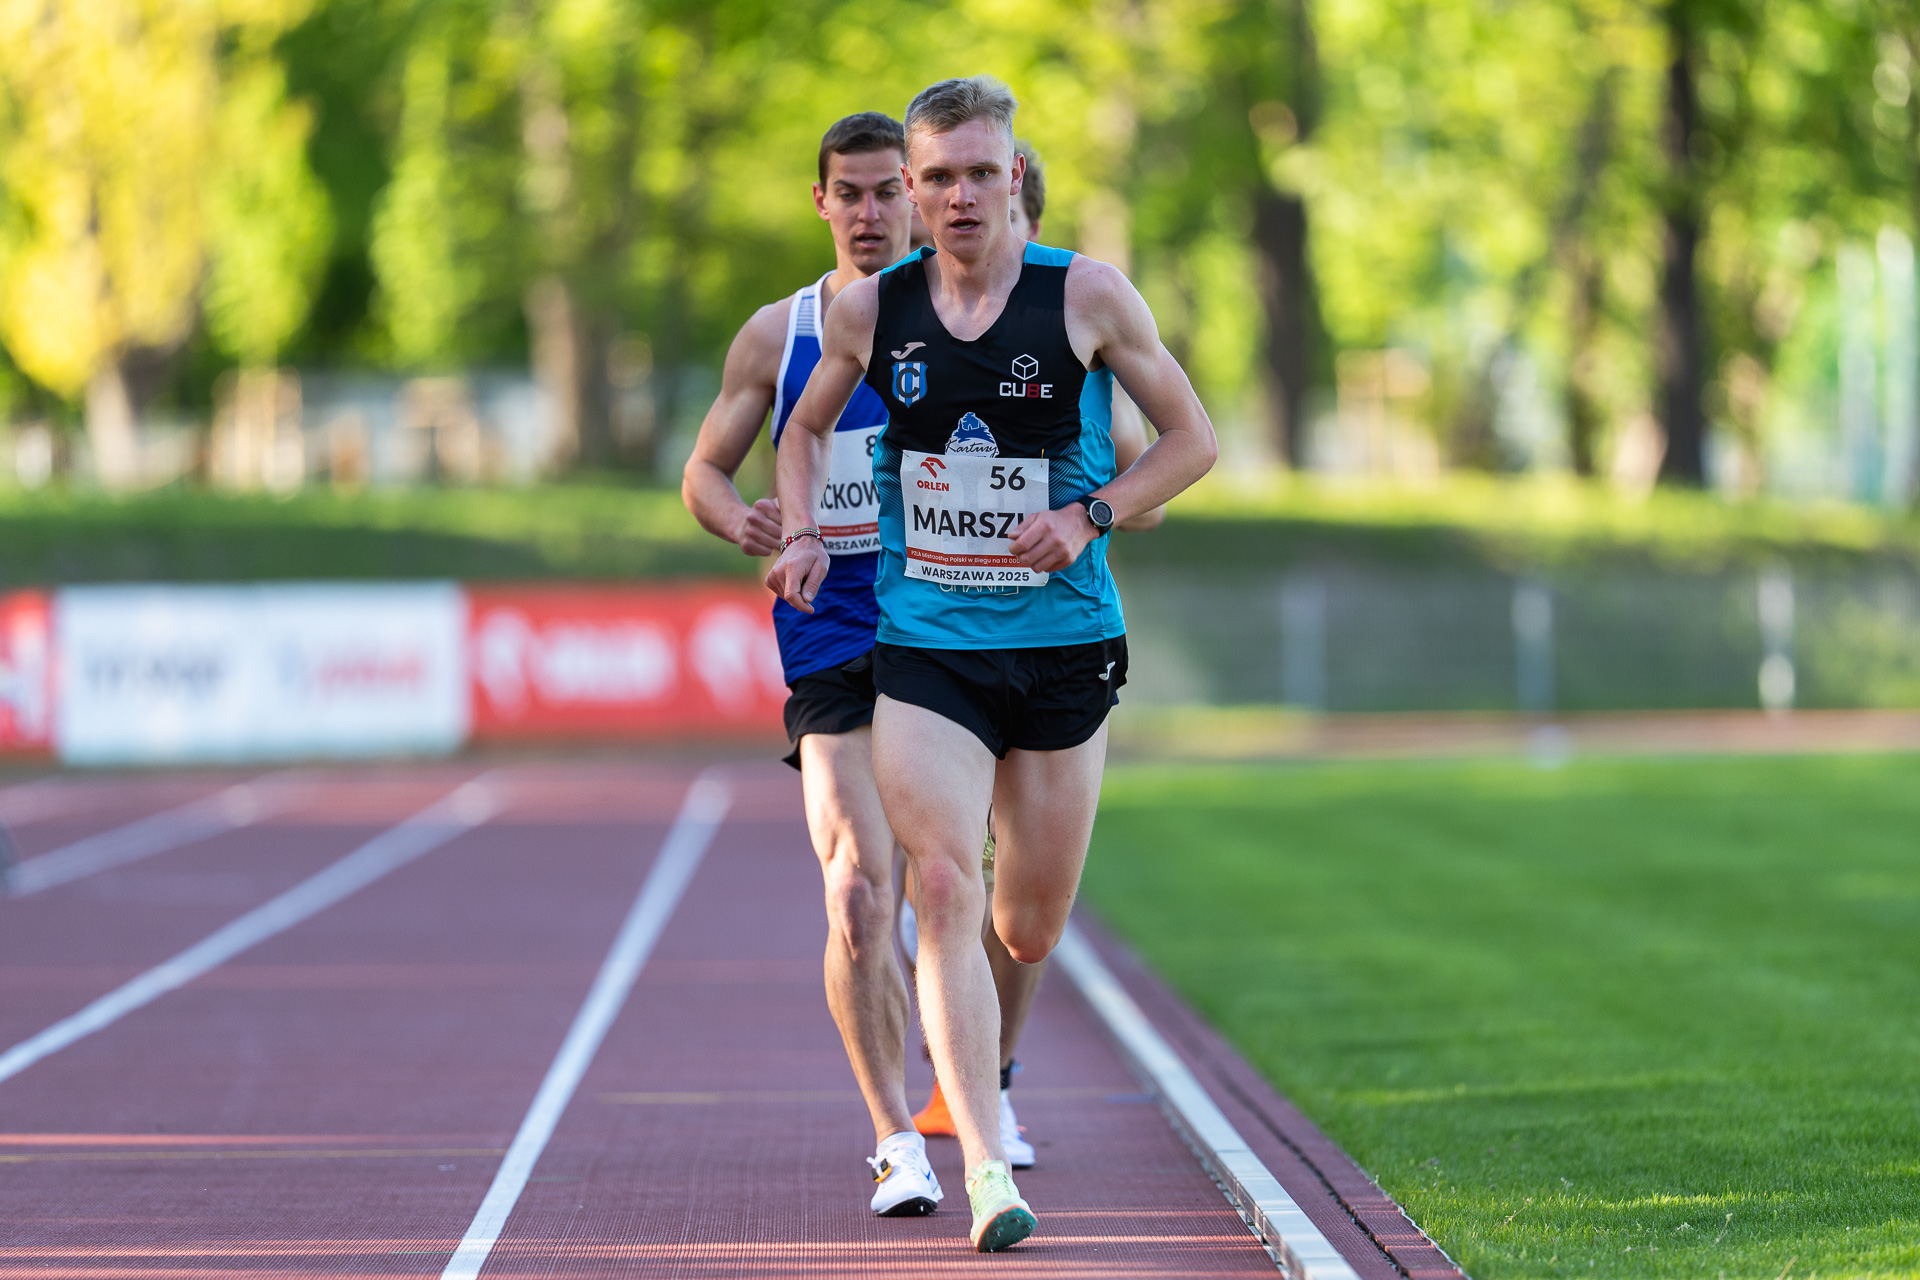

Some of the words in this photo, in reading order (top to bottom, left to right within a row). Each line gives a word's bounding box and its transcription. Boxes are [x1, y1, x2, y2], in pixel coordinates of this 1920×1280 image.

[1000, 382, 1053, 398] CUBE
[917, 480, 950, 491] ORLEN
[989, 466, 1026, 490] 56
[820, 477, 881, 512] ĆKOW
[823, 537, 880, 550] ARSZAWA
[974, 557, 992, 565] Biegu
[921, 565, 994, 581] WARSZAWA
[998, 571, 1030, 582] 2025
